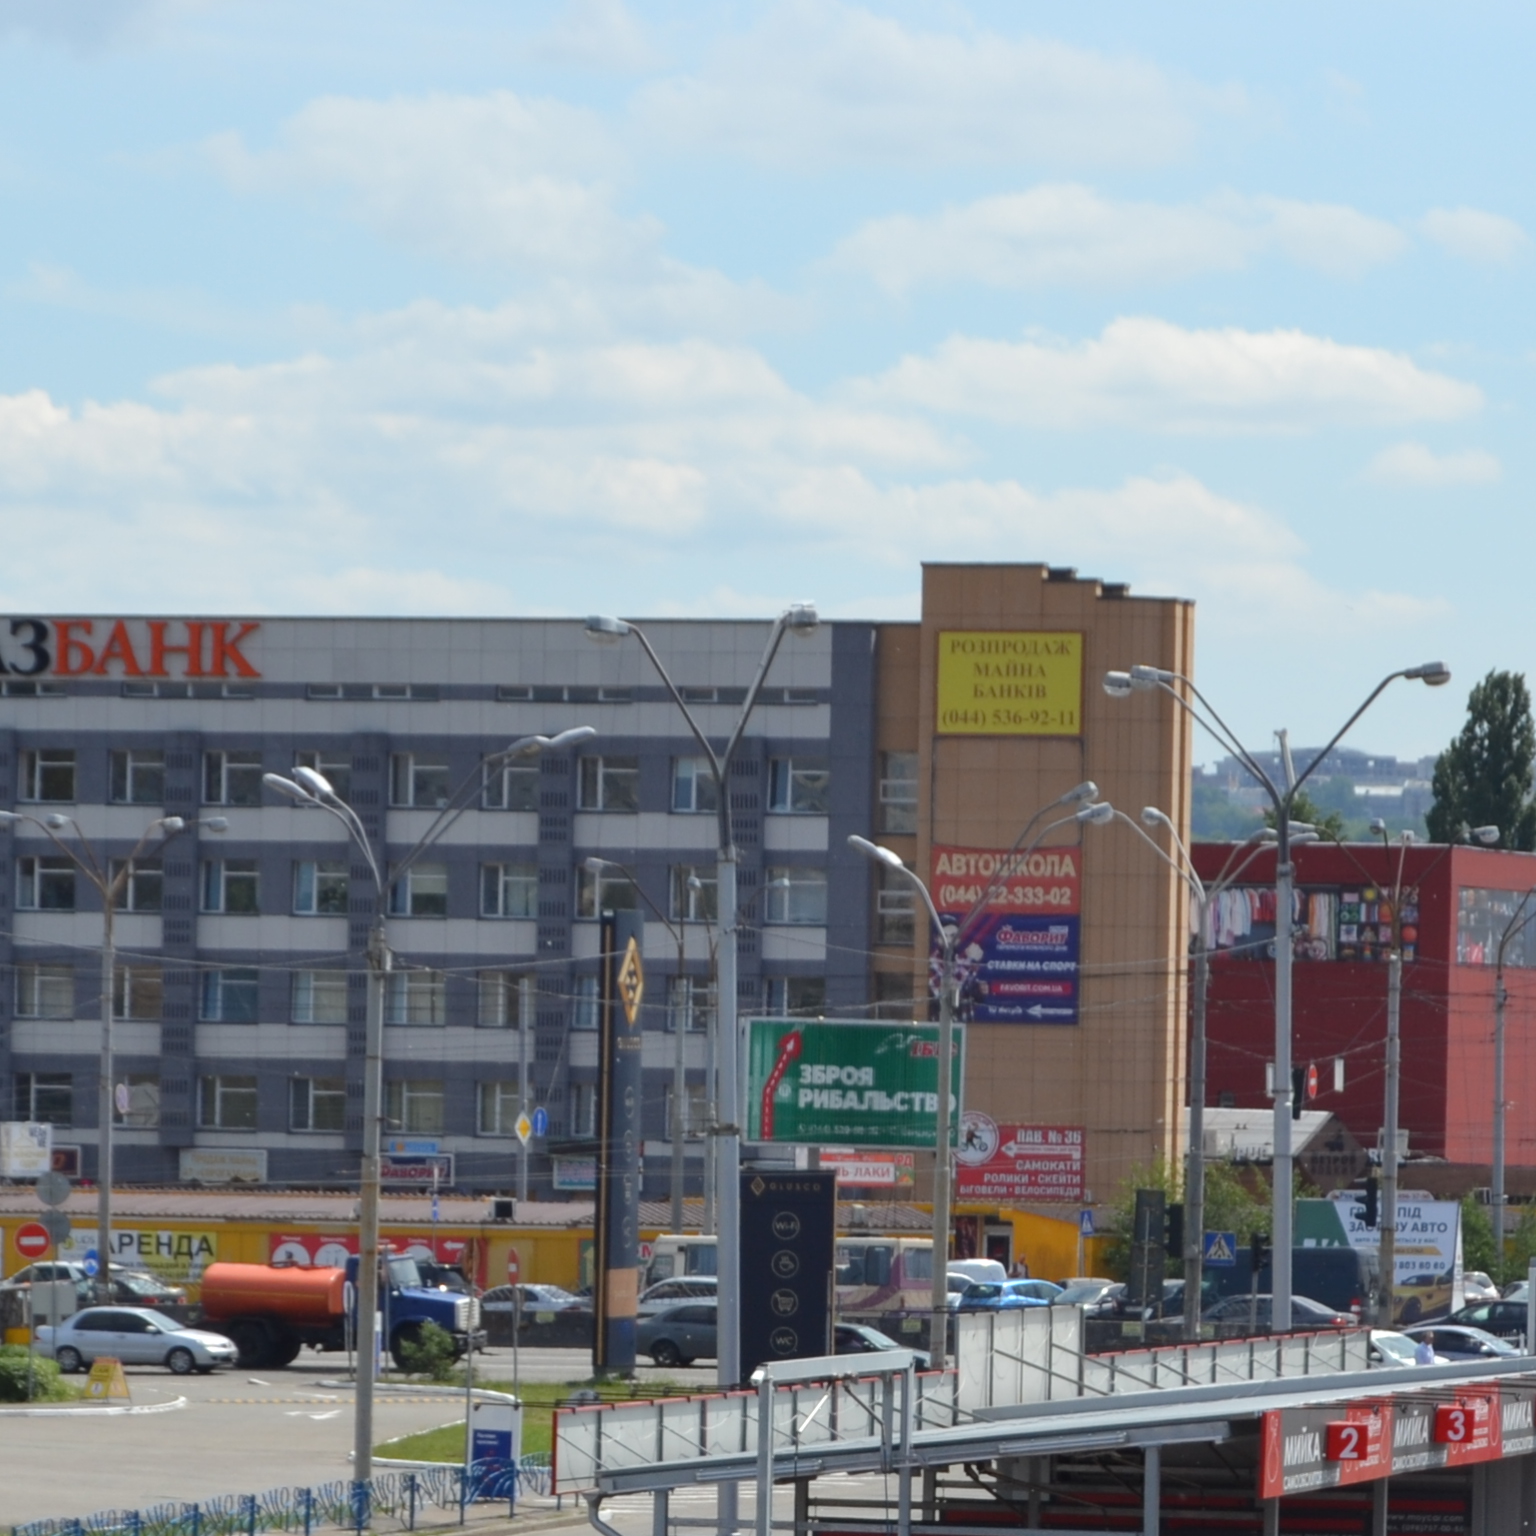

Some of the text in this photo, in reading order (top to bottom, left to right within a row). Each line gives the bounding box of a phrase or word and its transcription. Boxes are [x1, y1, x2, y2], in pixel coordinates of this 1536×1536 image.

[951, 639, 1071, 656] РОЗПРОДАЖ
[974, 660, 1046, 677] МАЙНА
[973, 683, 1046, 699] БАНКІВ
[942, 709, 1075, 727] (044) 536-92-11
[935, 852, 1076, 877] АВТОШКОЛА
[939, 884, 982, 907] (044)
[987, 960, 1077, 971] СТАВКИ НА СПОРТ
[1000, 984, 1063, 992] FAVORIT.COM.UA
[799, 1064, 874, 1087] ЗБРОЯ
[1017, 1130, 1045, 1143] ПАВ.
[1064, 1130, 1081, 1144] 36
[855, 1166, 890, 1178] ЛАКИ
[1016, 1160, 1081, 1172] САМОКАТИ
[984, 1173, 1081, 1185] РОЛИКИ СКЕЙТИ
[1014, 1186, 1081, 1197] ВЕЛОСИПЕДИ
[1398, 1207, 1422, 1219] ПІД
[1411, 1222, 1448, 1233] АВТО
[775, 1336, 794, 1346] WC
[1393, 1410, 1429, 1449] МИЙКА
[1447, 1410, 1466, 1442] 3
[1284, 1427, 1321, 1467] МИЙКА
[1339, 1427, 1359, 1458] 2
